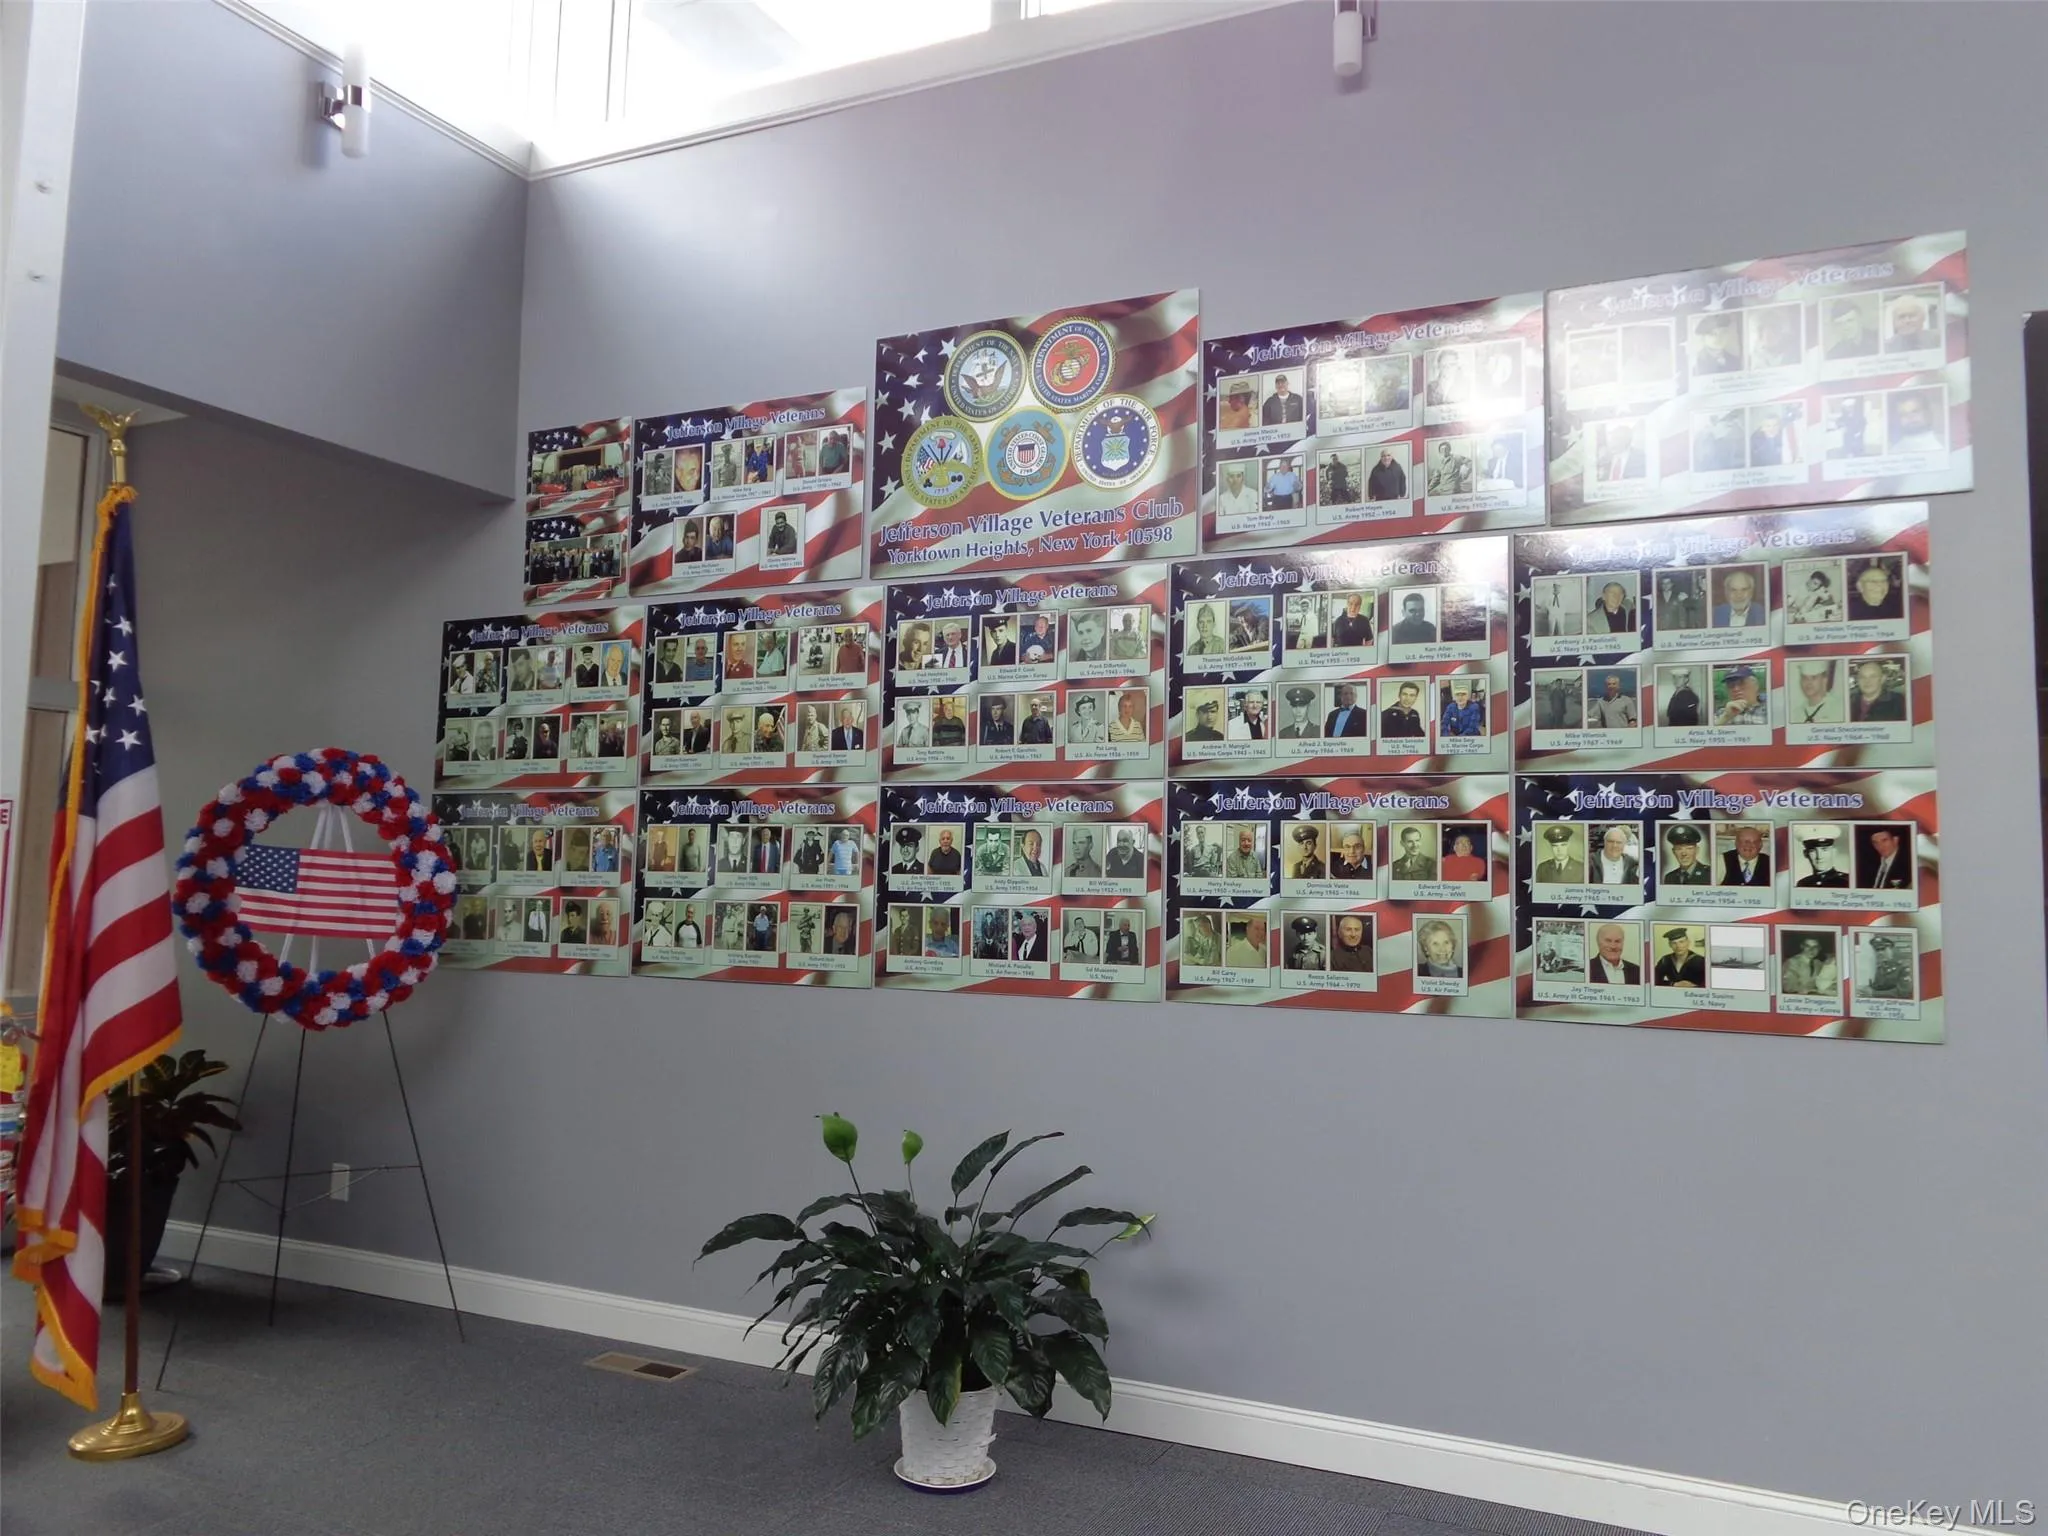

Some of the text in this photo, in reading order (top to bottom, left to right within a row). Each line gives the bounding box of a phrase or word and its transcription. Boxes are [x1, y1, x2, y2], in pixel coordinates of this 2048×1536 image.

[1036, 325, 1073, 369] DEPARTMENT
[1084, 327, 1095, 338] THE
[1094, 335, 1107, 358] NAVY
[1250, 340, 1333, 365] Jefferson
[1335, 331, 1399, 352] Village
[666, 407, 826, 442] Jefferson Village Veterans
[1075, 398, 1157, 463] DEPARTMENT OF THE AIR FORCE
[879, 496, 1185, 547] Jefferson Village Veterans Club
[888, 525, 1174, 566] Yorktown Heights, New York 10598
[1754, 527, 1856, 549] Veterans
[1218, 569, 1299, 590] Jefferson
[927, 583, 1118, 612] Jefferson Village Veterans
[679, 603, 842, 630] Jefferson Village Veterans
[470, 621, 609, 645] Jefferson Village Veterans
[510, 804, 548, 821] Village
[551, 803, 600, 817] Veterans
[673, 799, 835, 819] Jefferson Village Veterans
[921, 797, 1114, 817] Jefferson Village Veterans
[1216, 792, 1450, 814] Jefferson Village Veterans
[1573, 788, 1864, 815] Jefferson Village Veterans
[1553, 993, 1570, 1001] Army
[1708, 1000, 1727, 1008] Navy
